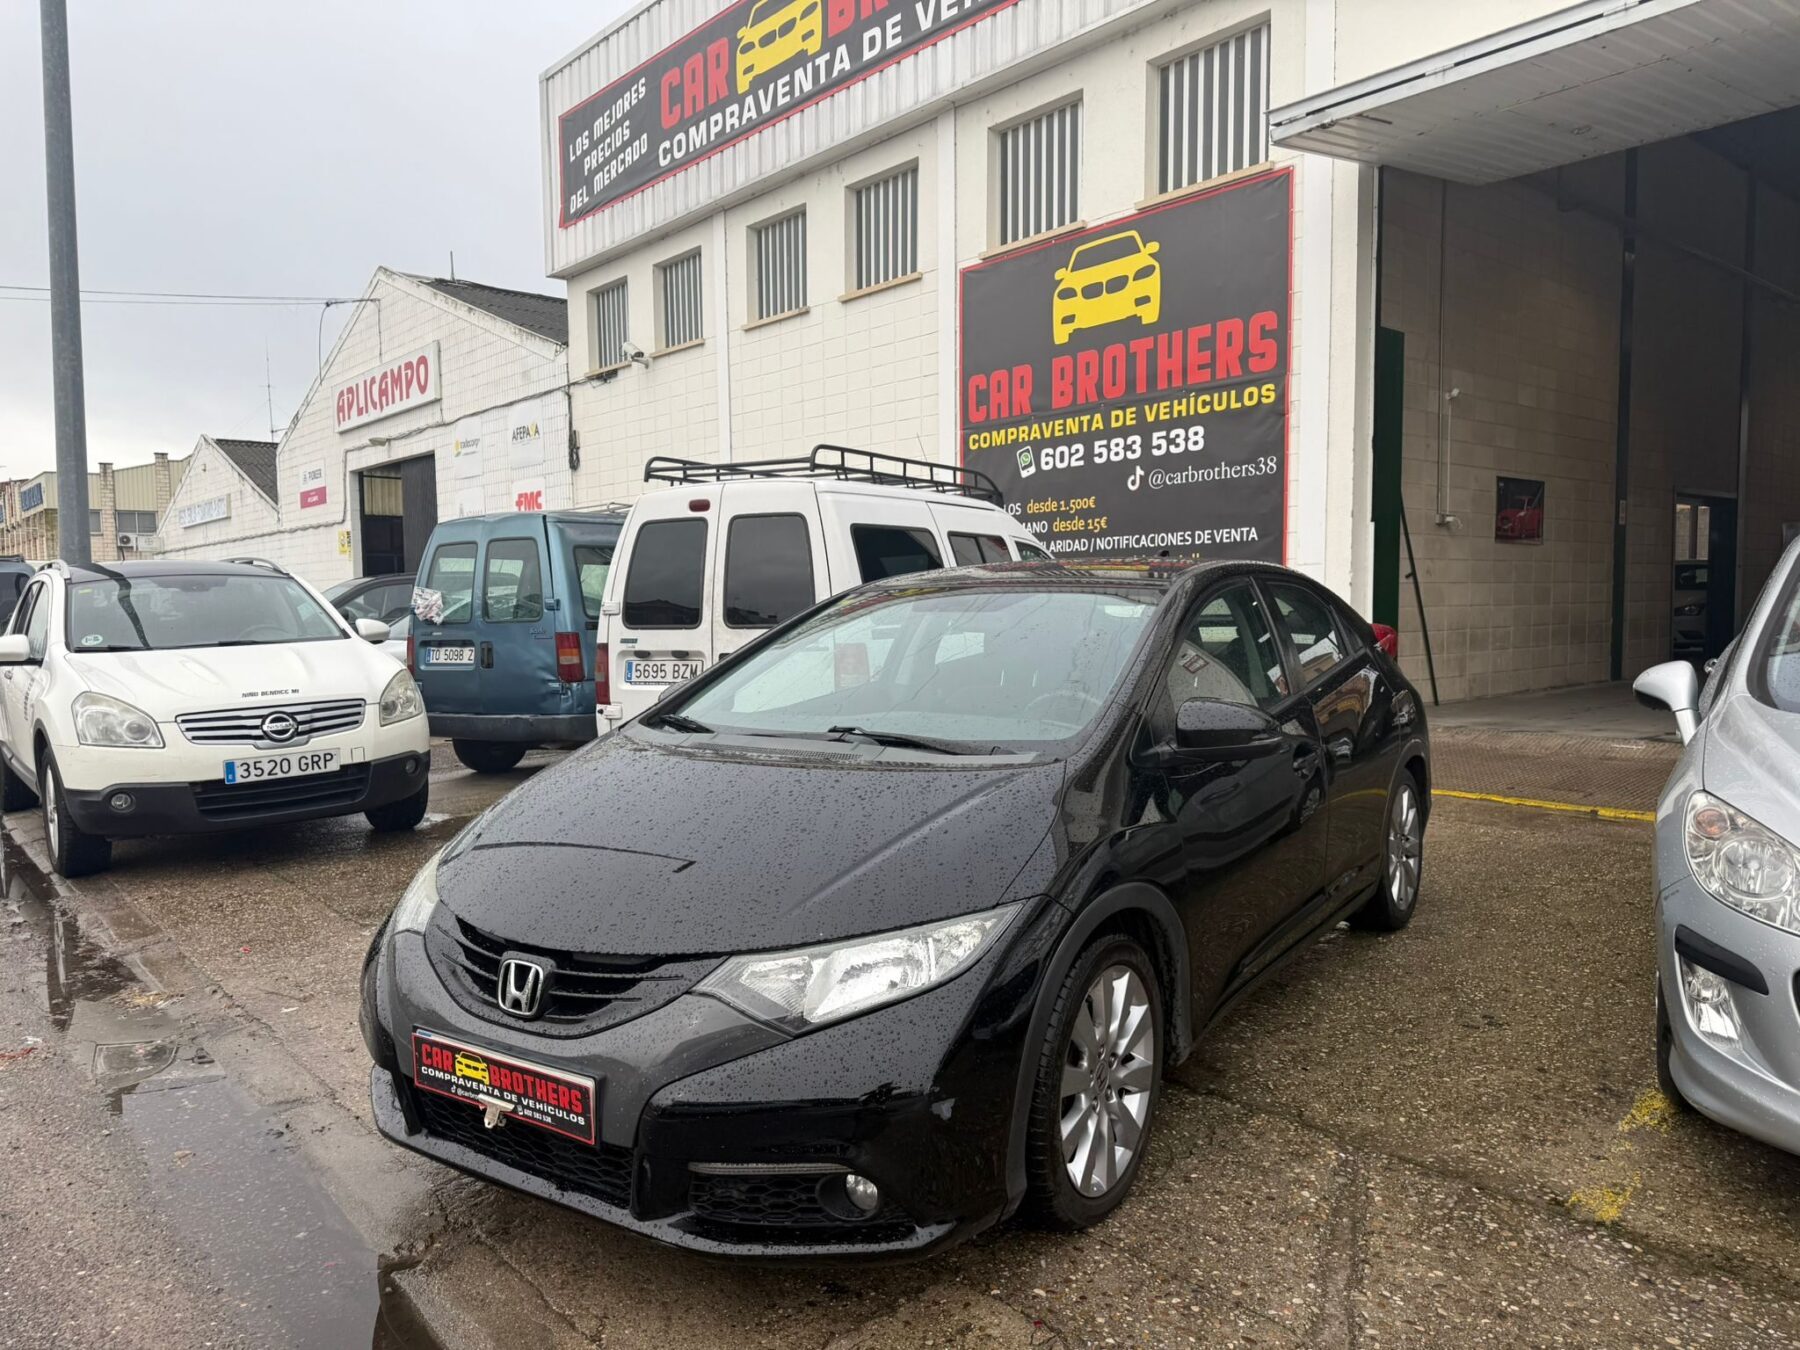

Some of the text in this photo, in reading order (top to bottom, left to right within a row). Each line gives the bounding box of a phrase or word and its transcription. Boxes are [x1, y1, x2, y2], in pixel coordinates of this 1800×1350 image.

[658, 43, 851, 167] COMPRAVENTA
[862, 12, 902, 62] DE
[660, 36, 730, 130] CAR
[569, 77, 646, 163] LOS MEJORES
[584, 120, 630, 176] PRECIOS
[570, 132, 648, 215] DEL MERCADO
[336, 354, 429, 428] APLICAMPO
[968, 310, 1278, 423] CAR BROTHERS
[968, 383, 1277, 450] COMPRAVENTA DE VEHÍCULOS
[1040, 425, 1205, 471] 602 583 538
[1148, 455, 1277, 490] @carbrothers38
[1026, 497, 1058, 514] desde
[1059, 495, 1096, 514] 1.500€
[1052, 515, 1085, 533] desde
[1087, 516, 1108, 533] 15€
[1096, 531, 1192, 551] NOTIFICACIONES
[1194, 529, 1212, 545] DE
[1213, 526, 1259, 544] VENTA
[444, 649, 464, 661] 5098
[468, 649, 474, 661] Z
[634, 663, 698, 680] 5695 BZM
[239, 752, 334, 779] 3520 GRP
[421, 1066, 586, 1126] COMPRAVENTA DE VEHÍCULOS
[422, 1043, 583, 1114] CAR BROTHERS
